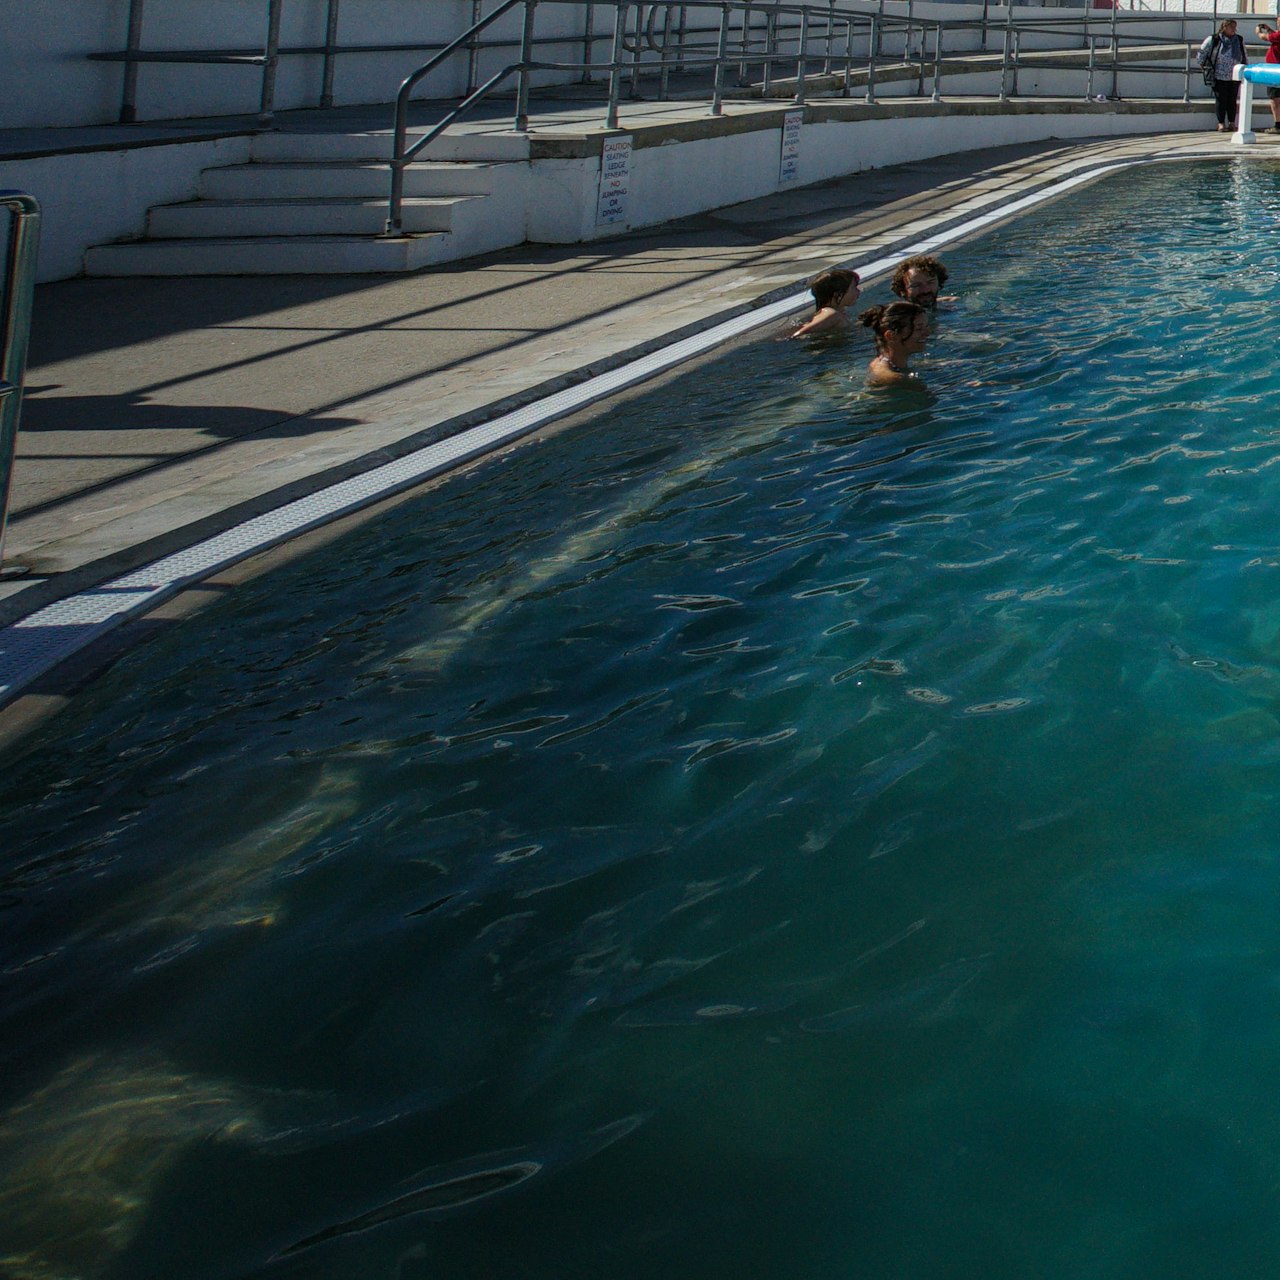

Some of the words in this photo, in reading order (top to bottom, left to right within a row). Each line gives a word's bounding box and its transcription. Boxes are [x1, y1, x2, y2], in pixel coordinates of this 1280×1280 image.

[604, 143, 632, 152] CAUTION
[606, 152, 629, 161] SEATING
[608, 161, 626, 170] LEDGE
[602, 188, 627, 199] JUMPING
[602, 207, 623, 217] DIVING
